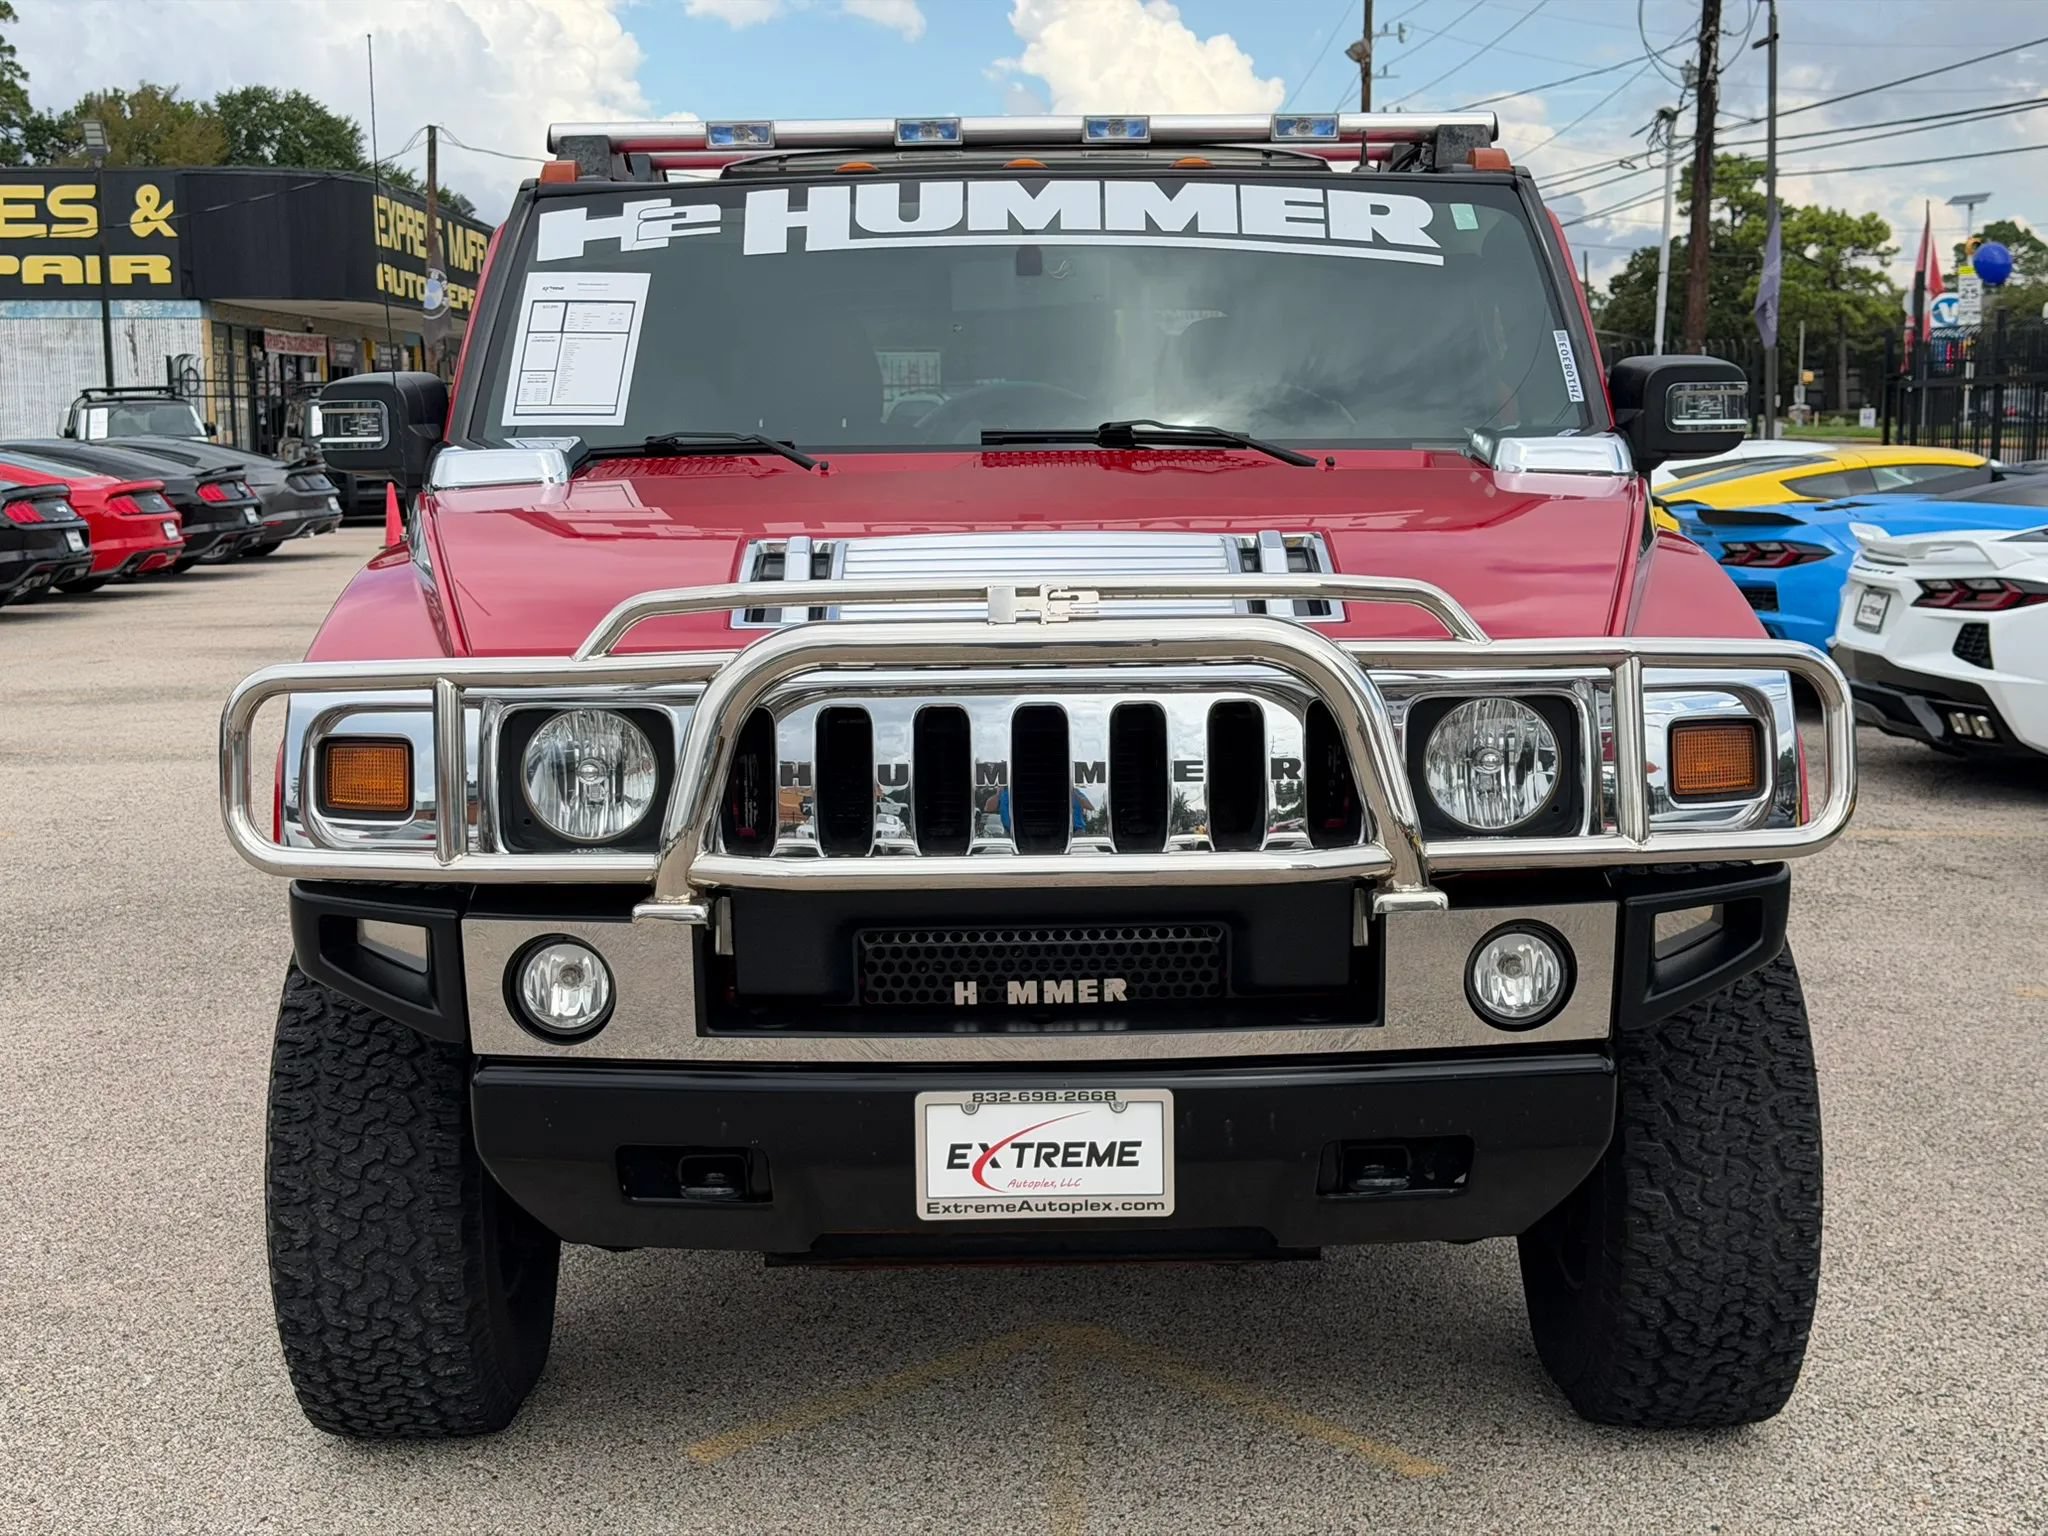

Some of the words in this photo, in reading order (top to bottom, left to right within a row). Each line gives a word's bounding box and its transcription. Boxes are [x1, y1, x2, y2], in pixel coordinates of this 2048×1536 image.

[131, 183, 179, 238] &
[537, 198, 721, 261] H2
[744, 180, 1443, 263] HUMMER
[376, 262, 427, 302] AUTO
[986, 584, 1100, 625] H2
[780, 757, 1302, 787] HUMMER
[972, 1090, 1117, 1103] 832-698-2668
[946, 1140, 1143, 1171] EXTREME
[1007, 1177, 1057, 1190] Autoplex,
[1060, 1177, 1083, 1188] LLC
[926, 1200, 1166, 1215] ExtremeAutoplex.com
